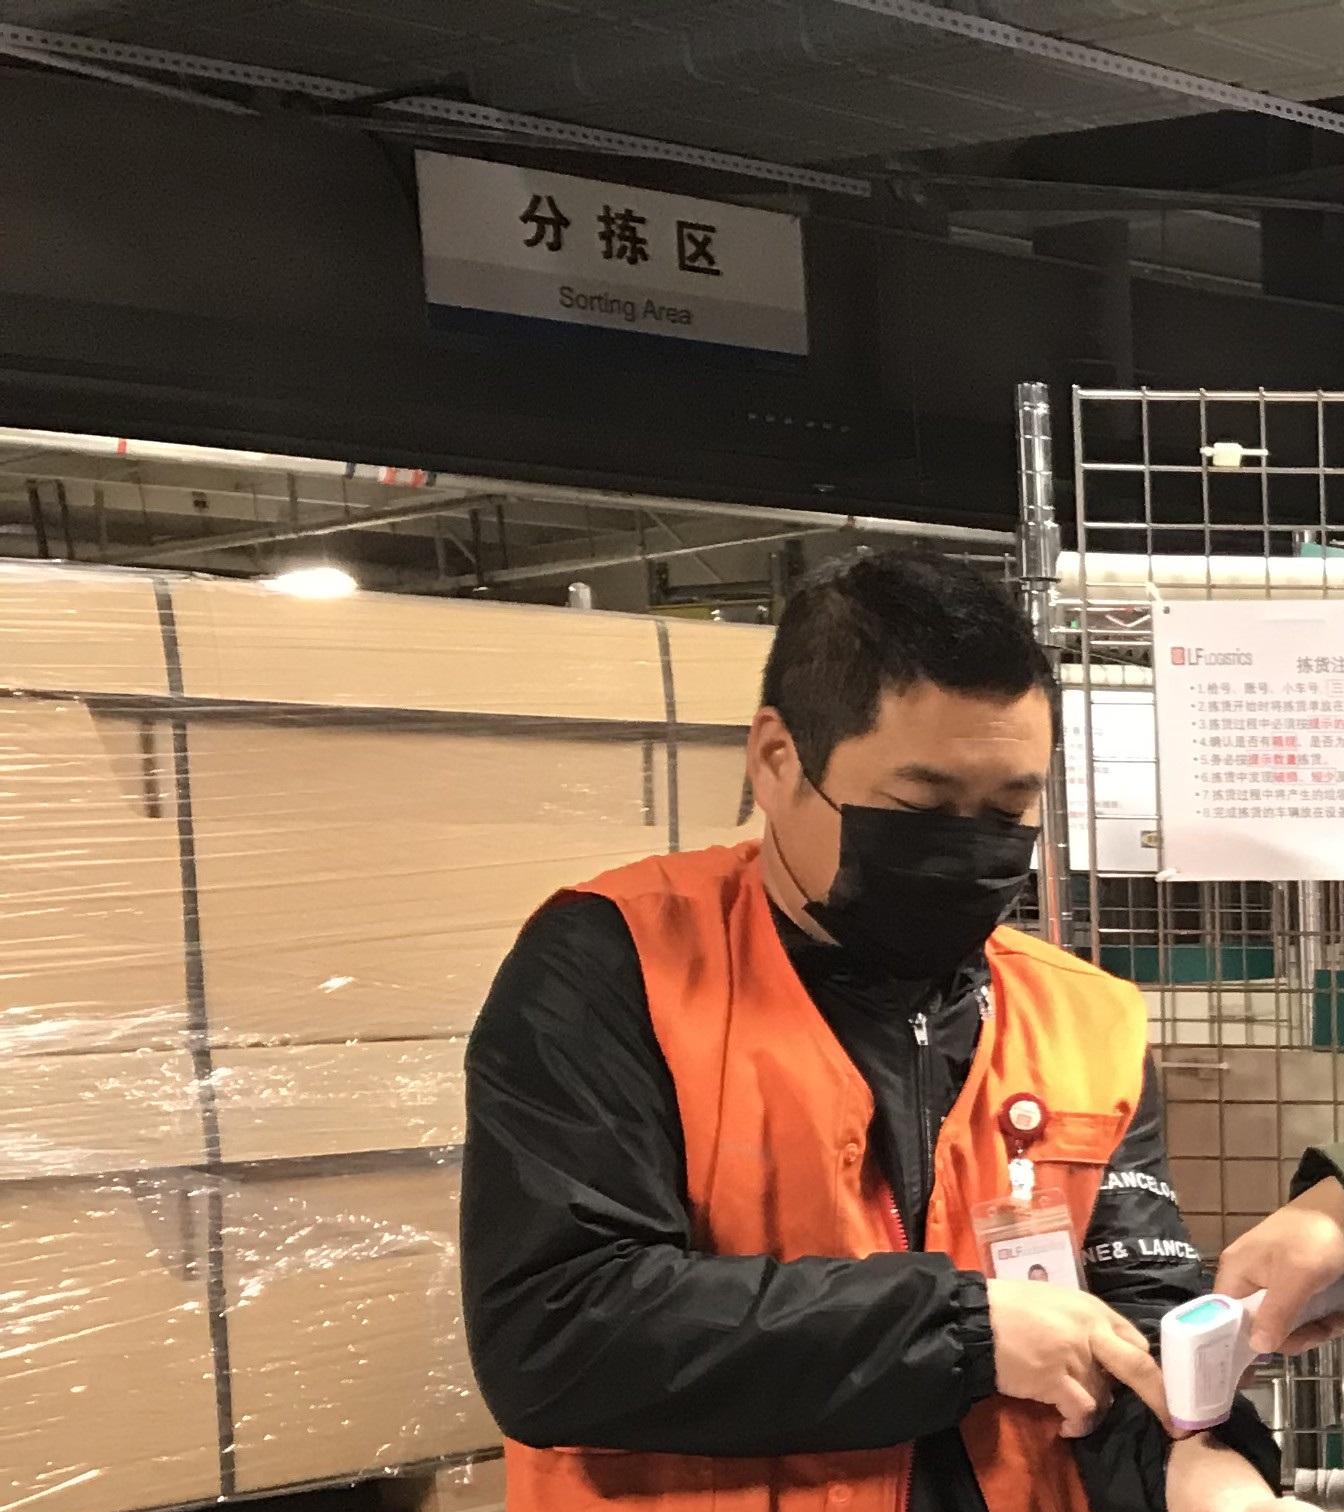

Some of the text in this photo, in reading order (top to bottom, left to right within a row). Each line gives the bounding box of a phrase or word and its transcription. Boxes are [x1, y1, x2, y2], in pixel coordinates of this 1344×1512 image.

[519, 194, 723, 276] 分拣区
[559, 285, 693, 325] Sorting Area
[1138, 1239, 1201, 1262] LANCE
